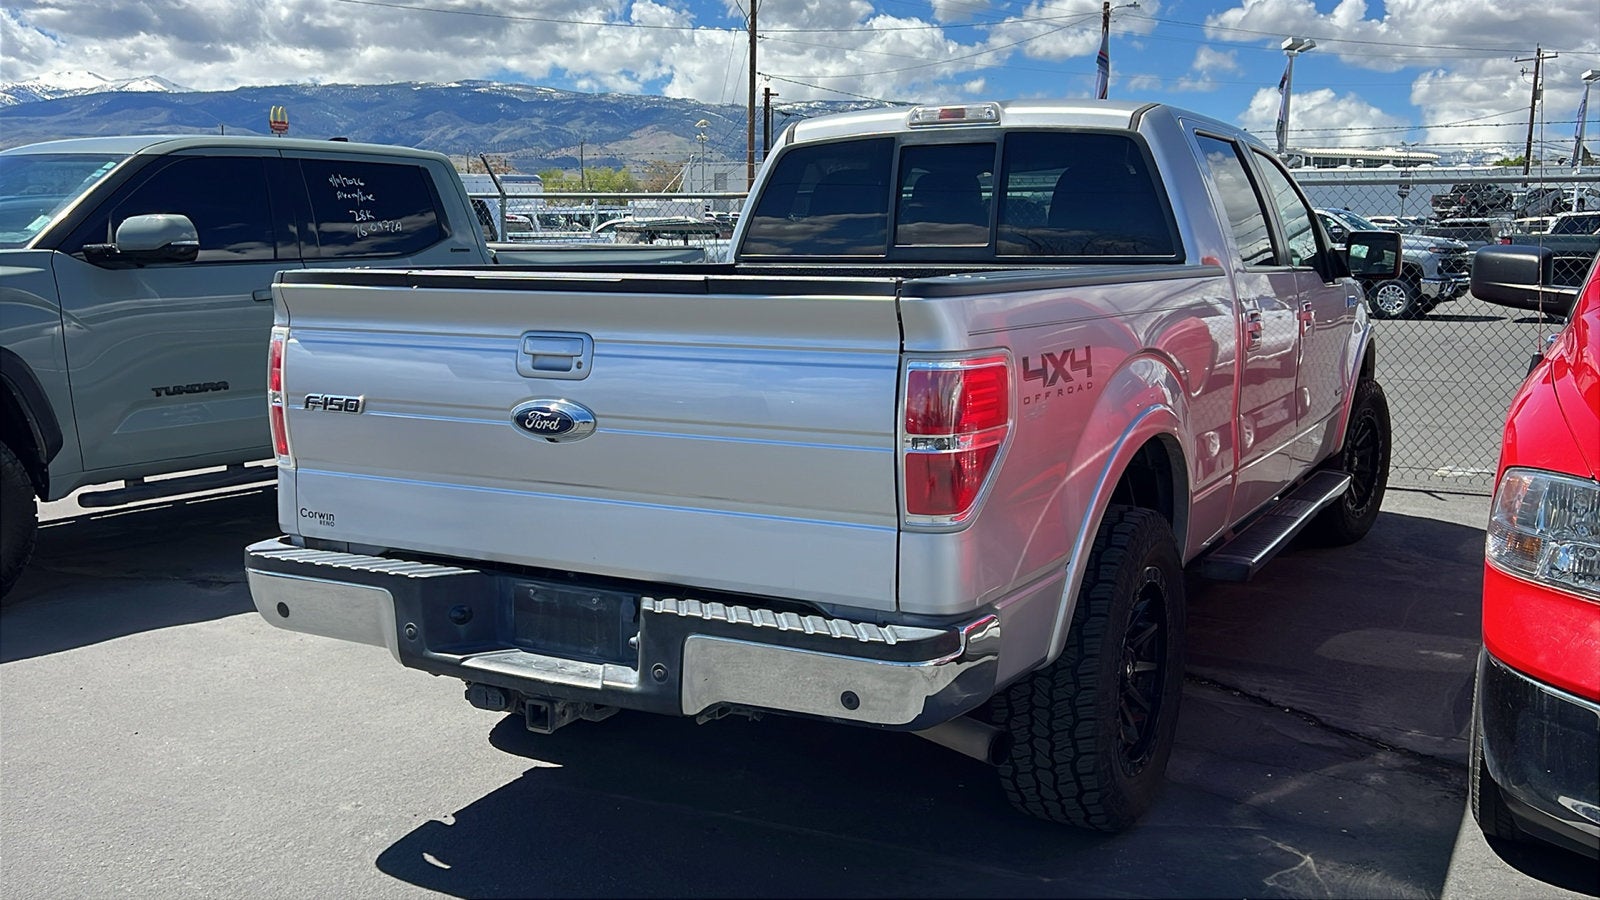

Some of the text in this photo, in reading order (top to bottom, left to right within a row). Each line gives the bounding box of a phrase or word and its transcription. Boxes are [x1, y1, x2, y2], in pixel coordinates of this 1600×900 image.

[152, 381, 230, 397] TUNDRA
[1023, 382, 1093, 405] OFF ROAD
[525, 410, 561, 431] Ford
[300, 507, 335, 522] Corwin
[319, 520, 335, 528] RENO
